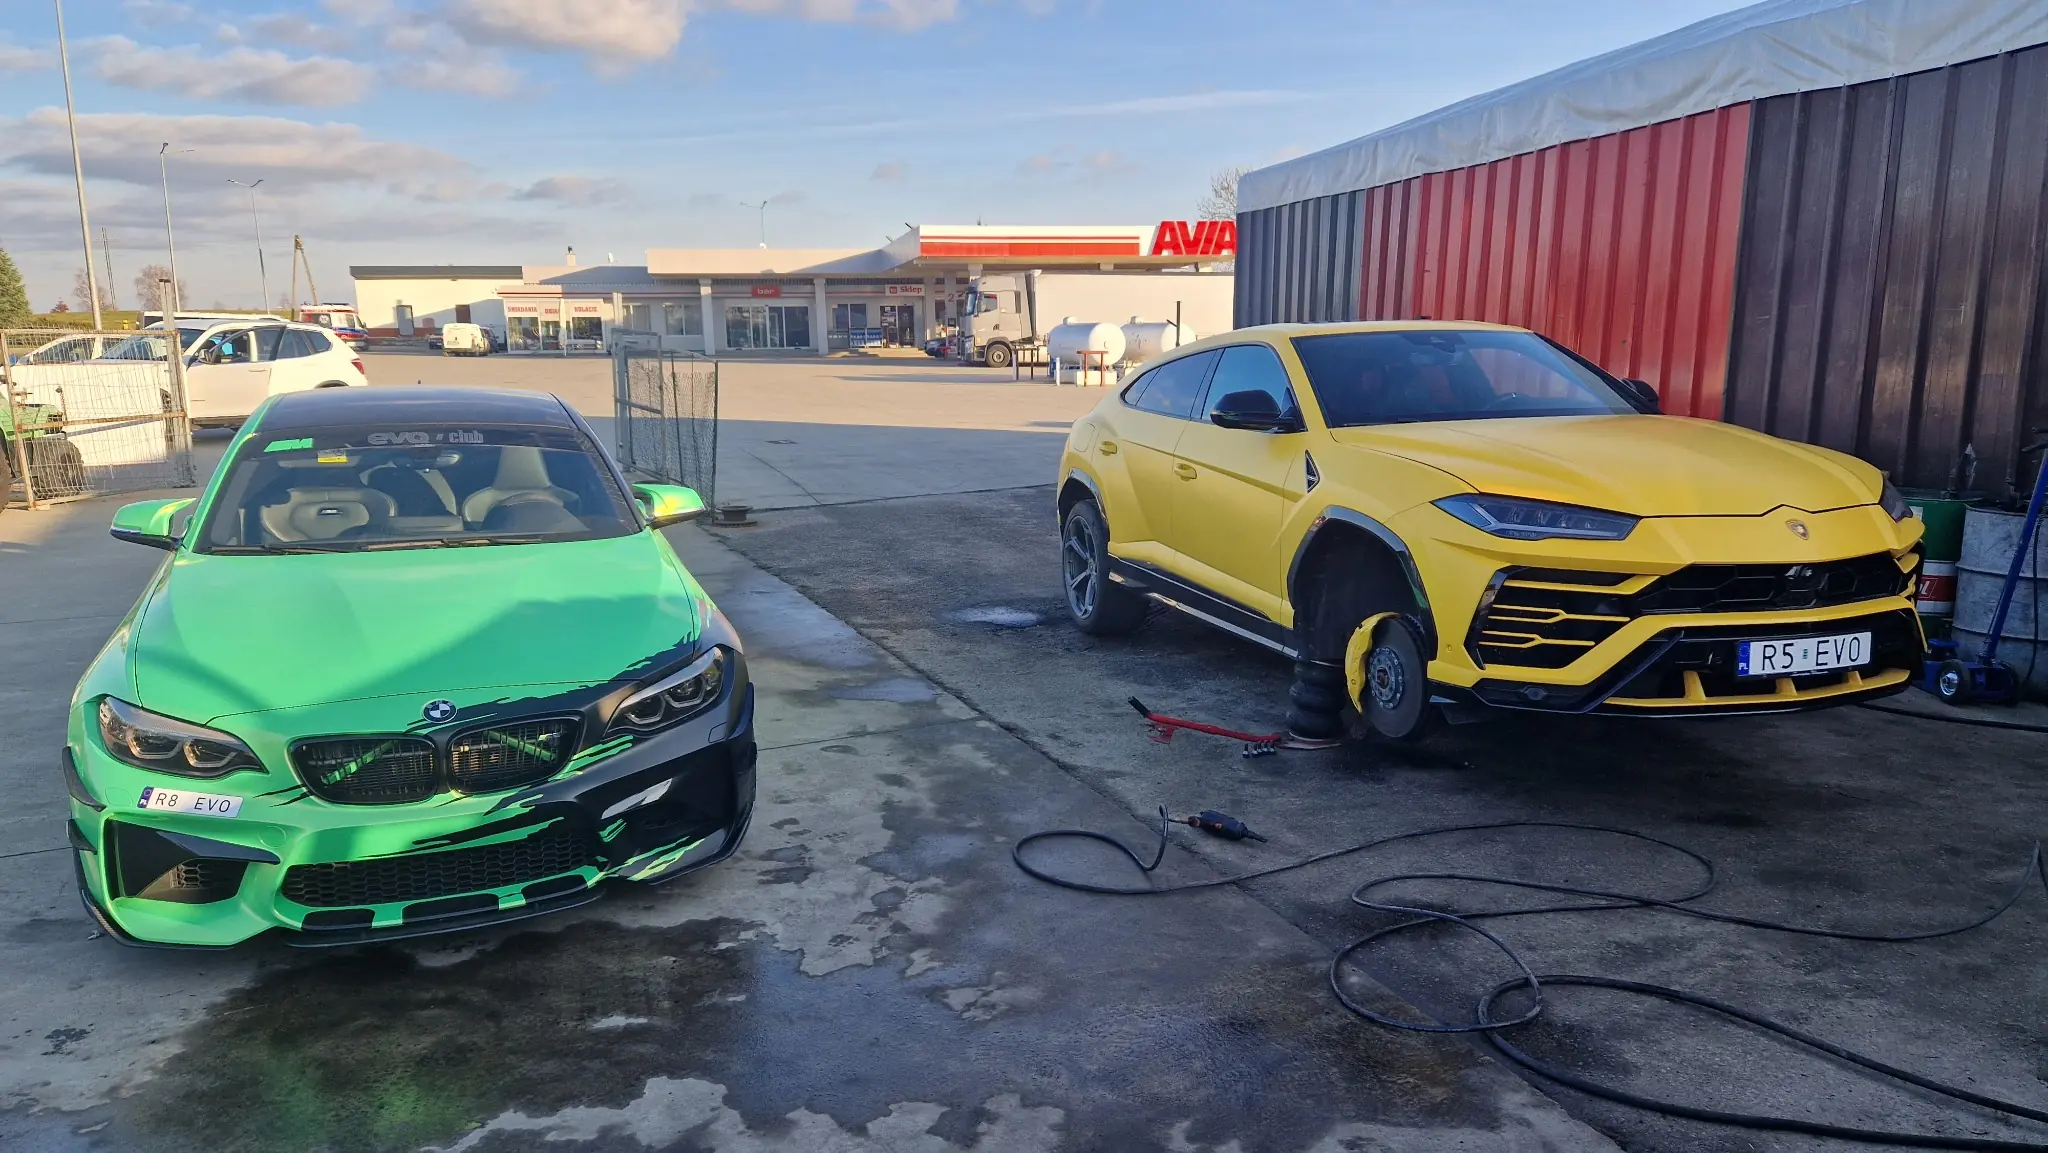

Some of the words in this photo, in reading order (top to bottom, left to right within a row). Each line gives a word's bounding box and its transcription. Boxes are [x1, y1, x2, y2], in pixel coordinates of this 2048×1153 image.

[1151, 220, 1236, 256] AVIA
[900, 285, 923, 294] Sklep
[448, 429, 484, 443] club
[1761, 643, 1794, 671] R5
[1815, 636, 1861, 667] EVO
[1738, 662, 1749, 671] PL
[155, 792, 179, 807] R8
[194, 797, 231, 813] EVO
